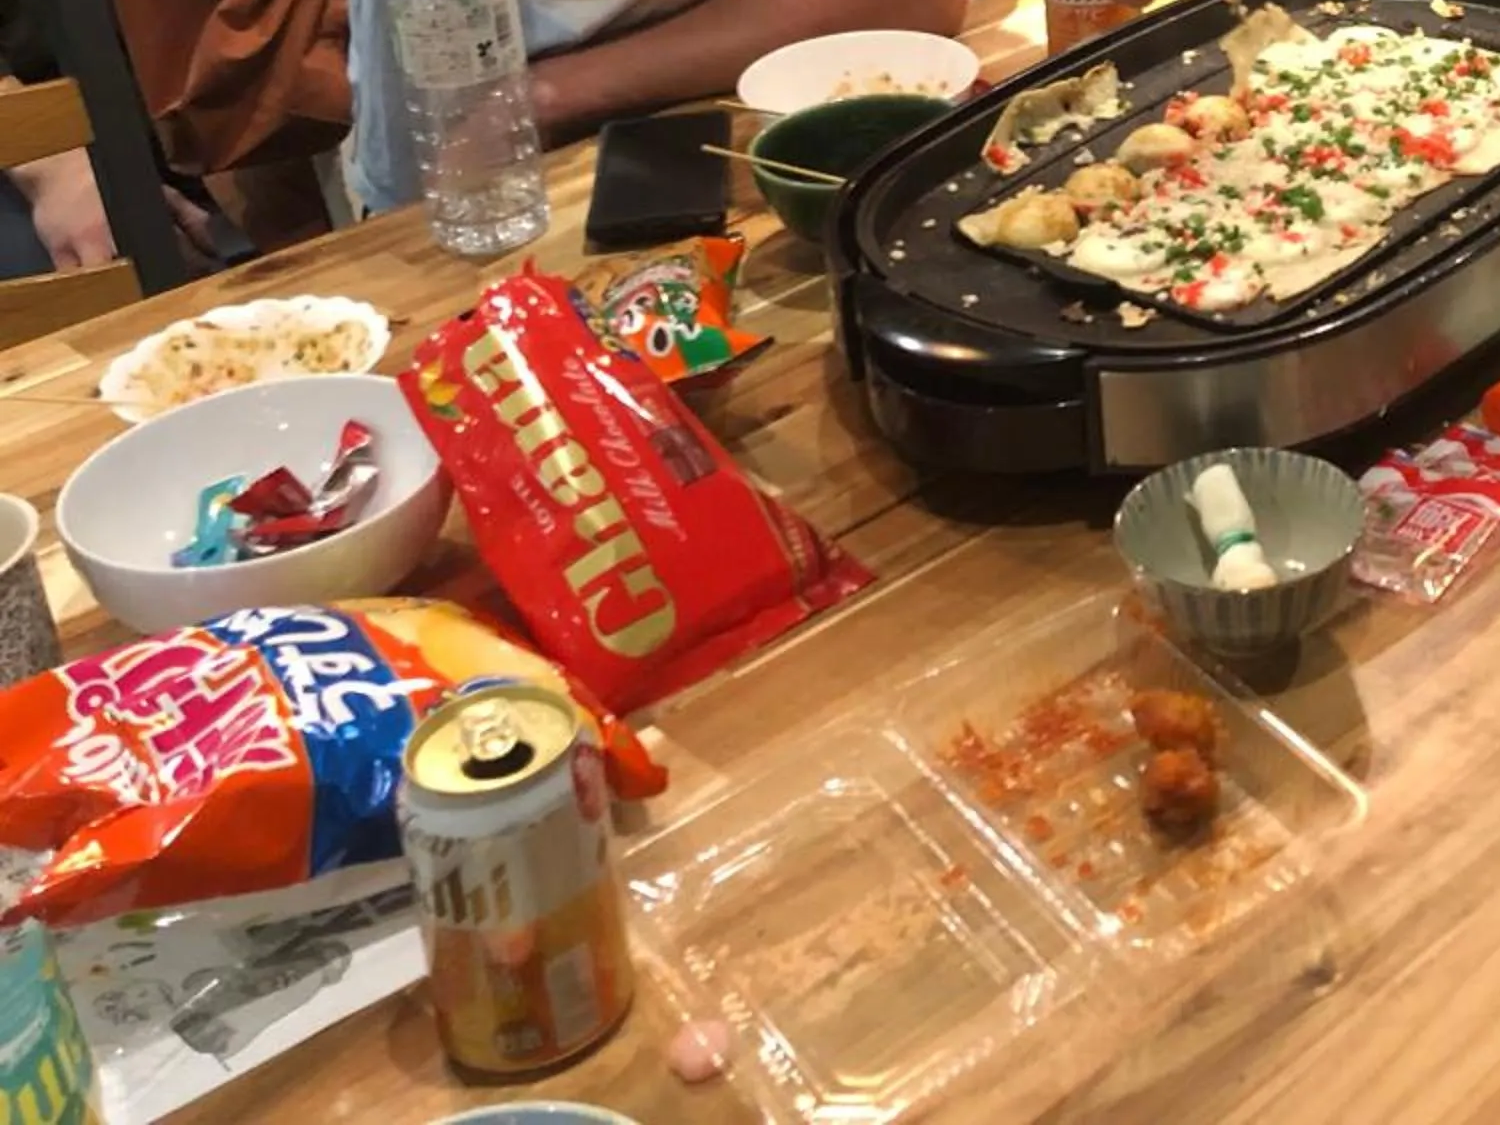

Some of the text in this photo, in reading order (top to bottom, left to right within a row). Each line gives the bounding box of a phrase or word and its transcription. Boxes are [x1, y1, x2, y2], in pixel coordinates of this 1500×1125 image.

[562, 355, 642, 469] Chocolate
[462, 325, 678, 659] Ghana
[510, 473, 557, 536] LOTTE
[624, 471, 689, 543] Milk
